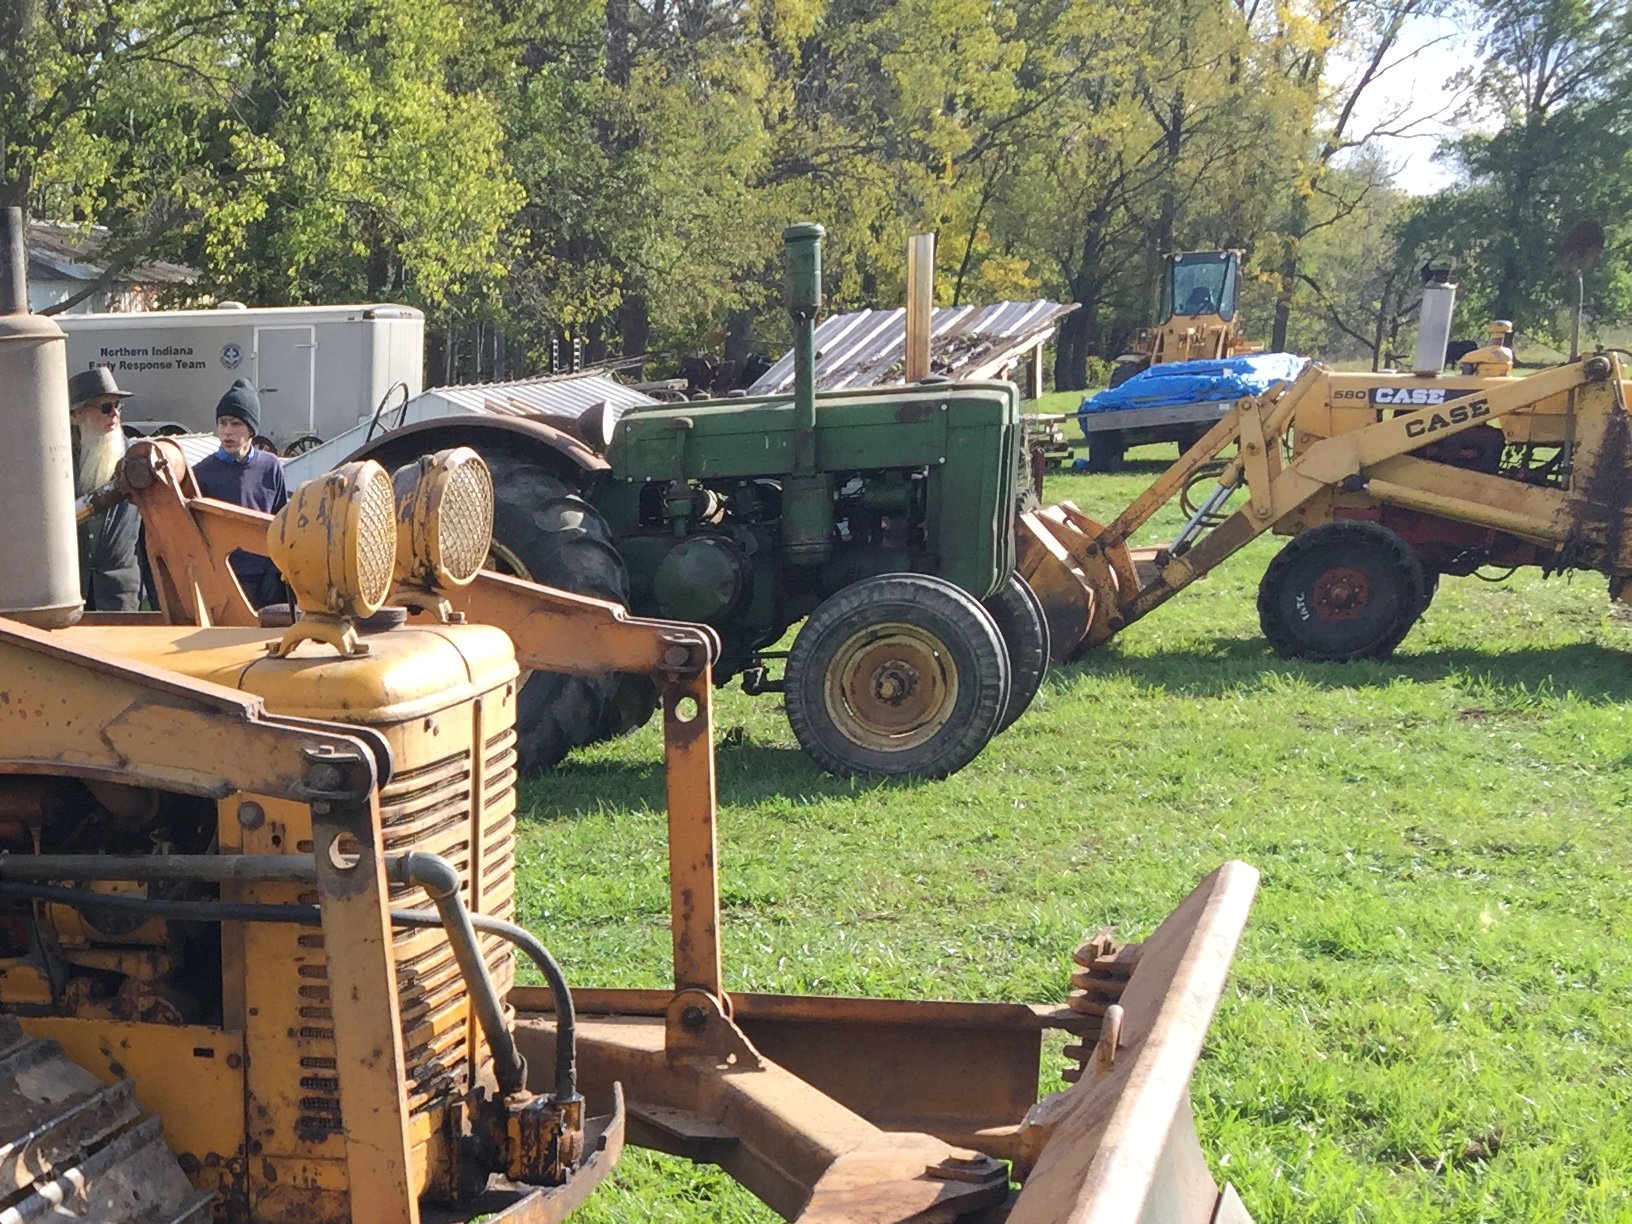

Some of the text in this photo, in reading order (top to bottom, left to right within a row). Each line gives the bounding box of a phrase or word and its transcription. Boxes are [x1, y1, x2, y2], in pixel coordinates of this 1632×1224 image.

[100, 346, 194, 357] Northern Indiana
[119, 361, 172, 372] Response
[175, 359, 206, 369] Team
[1333, 388, 1446, 404] 580 CASE
[1405, 398, 1491, 438] CASE
